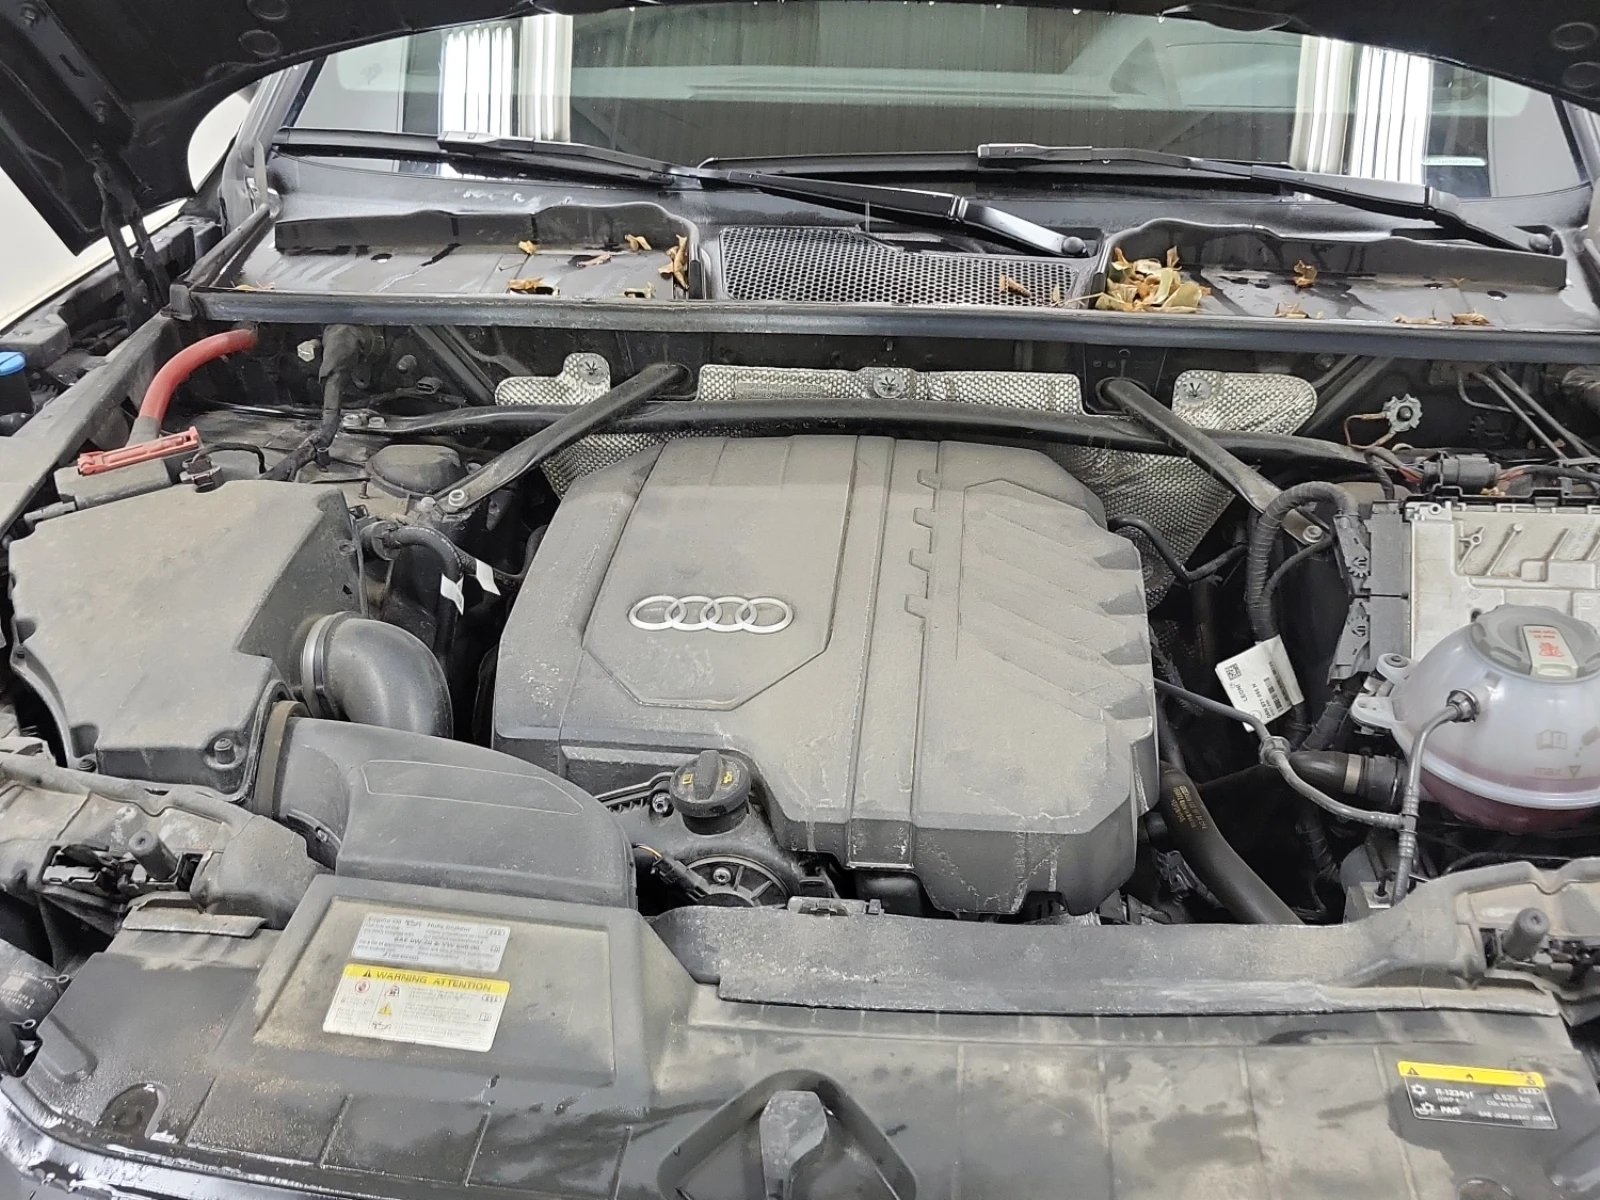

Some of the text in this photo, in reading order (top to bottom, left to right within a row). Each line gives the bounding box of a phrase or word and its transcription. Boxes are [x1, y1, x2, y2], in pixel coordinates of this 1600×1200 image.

[1535, 766, 1562, 776] max
[376, 971, 491, 992] WARNING ATTENTION
[1434, 1088, 1474, 1100] R-1234yf
[1440, 1106, 1461, 1115] PAG
